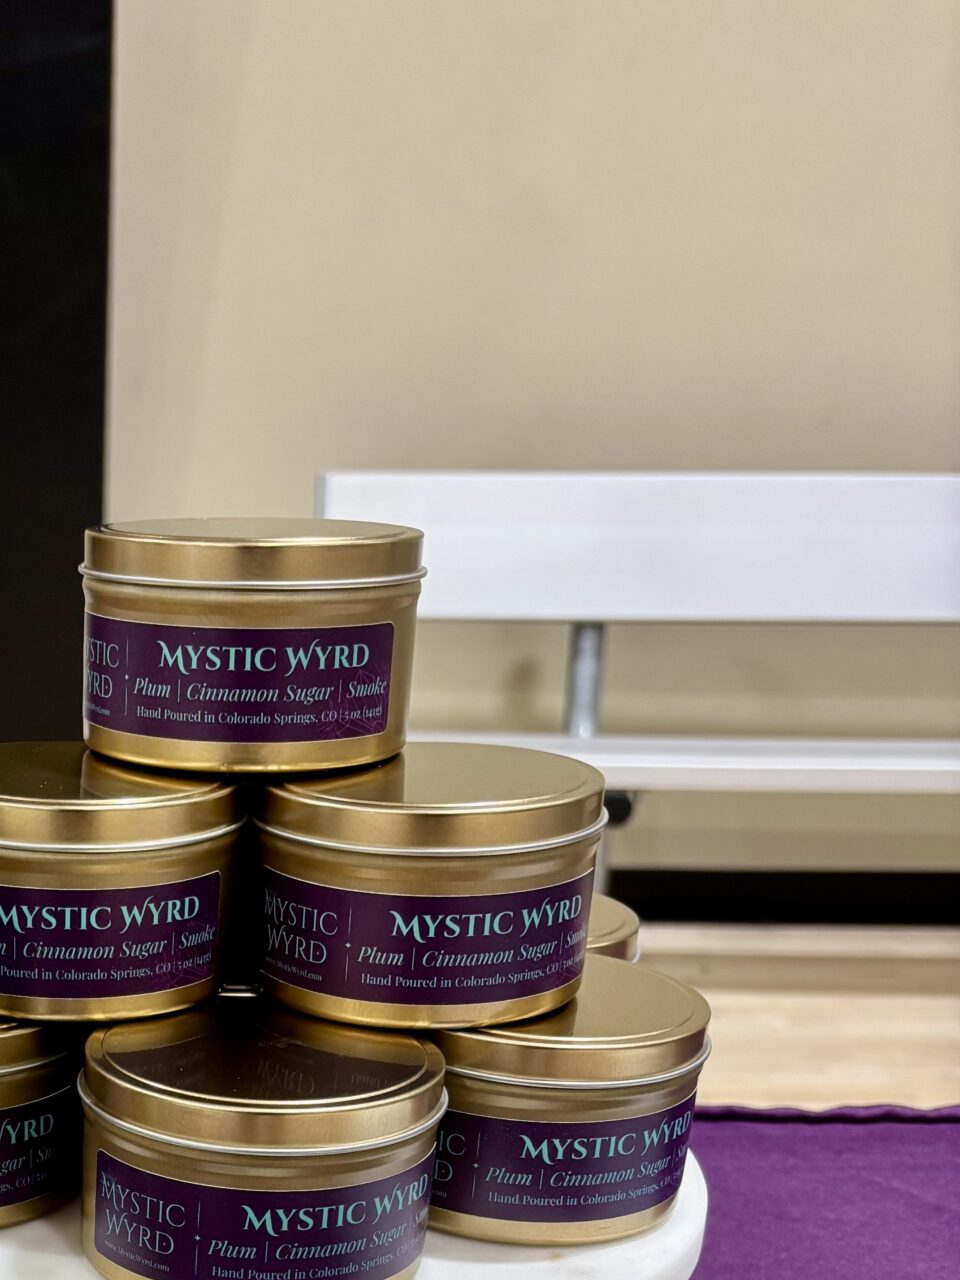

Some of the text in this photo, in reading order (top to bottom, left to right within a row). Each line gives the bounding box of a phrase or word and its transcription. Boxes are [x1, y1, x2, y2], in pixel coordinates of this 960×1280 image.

[156, 638, 371, 678] MYSTIC WYRD
[87, 662, 113, 699] YRD
[132, 677, 172, 698] Plum
[185, 681, 280, 703] Cinnamon
[283, 682, 335, 705] Sugar
[346, 675, 388, 699] Smoke
[136, 705, 162, 720] Hand
[163, 707, 202, 723] Poured
[203, 709, 216, 723] in
[218, 711, 272, 725] Colorado
[119, 895, 200, 935] WYRD
[264, 887, 339, 936] MYSTIC
[389, 894, 583, 944] MYSTIC WYRD
[22, 940, 115, 960] Cinnamon
[119, 937, 168, 960] Sugar
[178, 924, 216, 949] Smoke
[267, 923, 328, 965] WYRD
[356, 945, 405, 966] Plum
[421, 948, 515, 968] Cinnamon
[516, 939, 559, 962] Sugar
[0, 964, 39, 980] Poured
[41, 967, 53, 980] in
[55, 967, 108, 981] Colorado
[360, 972, 392, 986] Hand
[394, 974, 438, 989] Poured
[439, 975, 453, 988] in
[454, 972, 506, 988] Colorado
[518, 1133, 636, 1166] MYSTIC
[639, 1110, 692, 1157] WYRD
[484, 1167, 533, 1187] Plum
[549, 1166, 635, 1189] Cinnamon
[637, 1154, 672, 1178] Sugar
[101, 1170, 187, 1228] MYSTIC
[240, 1200, 367, 1237] MYSTIC
[371, 1172, 429, 1226] WYRD
[487, 1191, 520, 1204] Hand
[522, 1193, 564, 1207] Poured
[566, 1195, 578, 1206] in
[579, 1190, 627, 1206] Colorado
[105, 1208, 175, 1255] WYRD
[208, 1239, 257, 1261] Plum
[274, 1237, 367, 1261] Cinnamon
[369, 1223, 408, 1247] Sugar
[211, 1265, 245, 1280] Hand
[247, 1267, 291, 1280] Poured
[294, 1267, 307, 1280] in
[309, 1261, 359, 1280] Colorado
